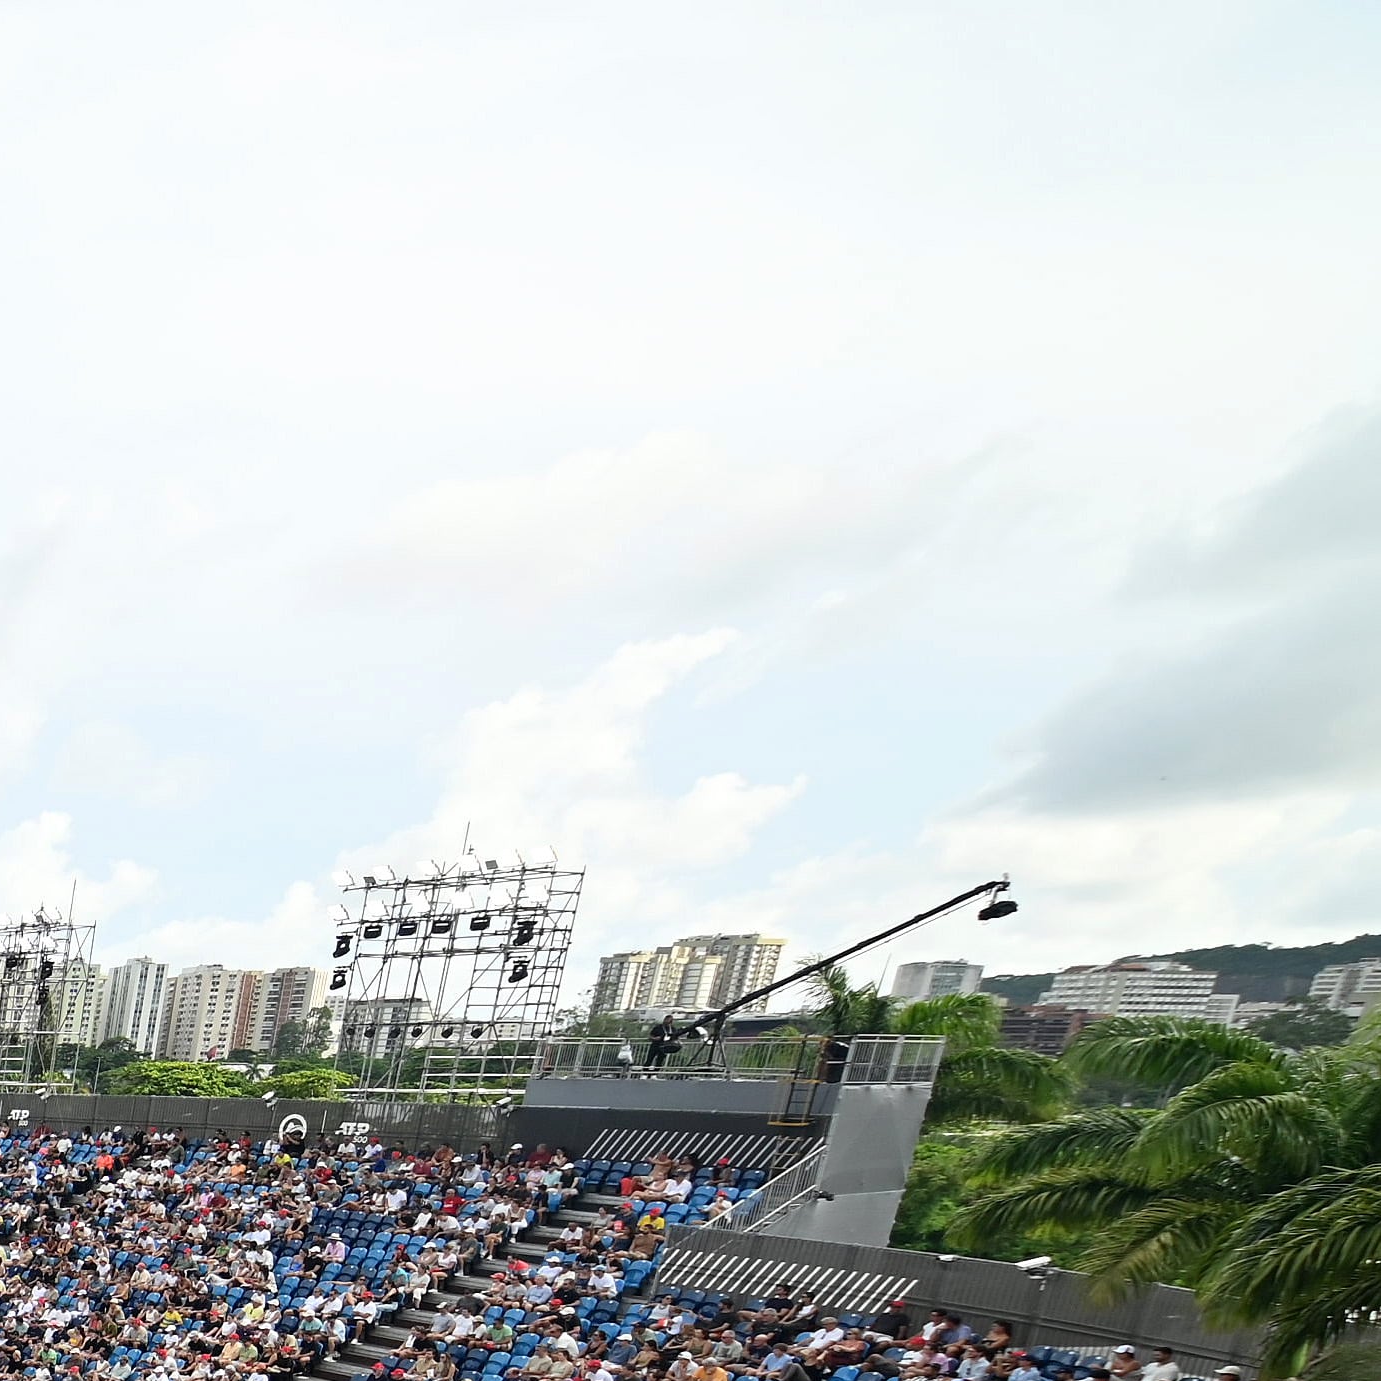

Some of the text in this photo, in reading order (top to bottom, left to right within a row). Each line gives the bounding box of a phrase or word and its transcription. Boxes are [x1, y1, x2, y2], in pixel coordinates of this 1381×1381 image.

[7, 1109, 30, 1120] ATP
[334, 1121, 371, 1136] ATP
[352, 1135, 368, 1143] 500
